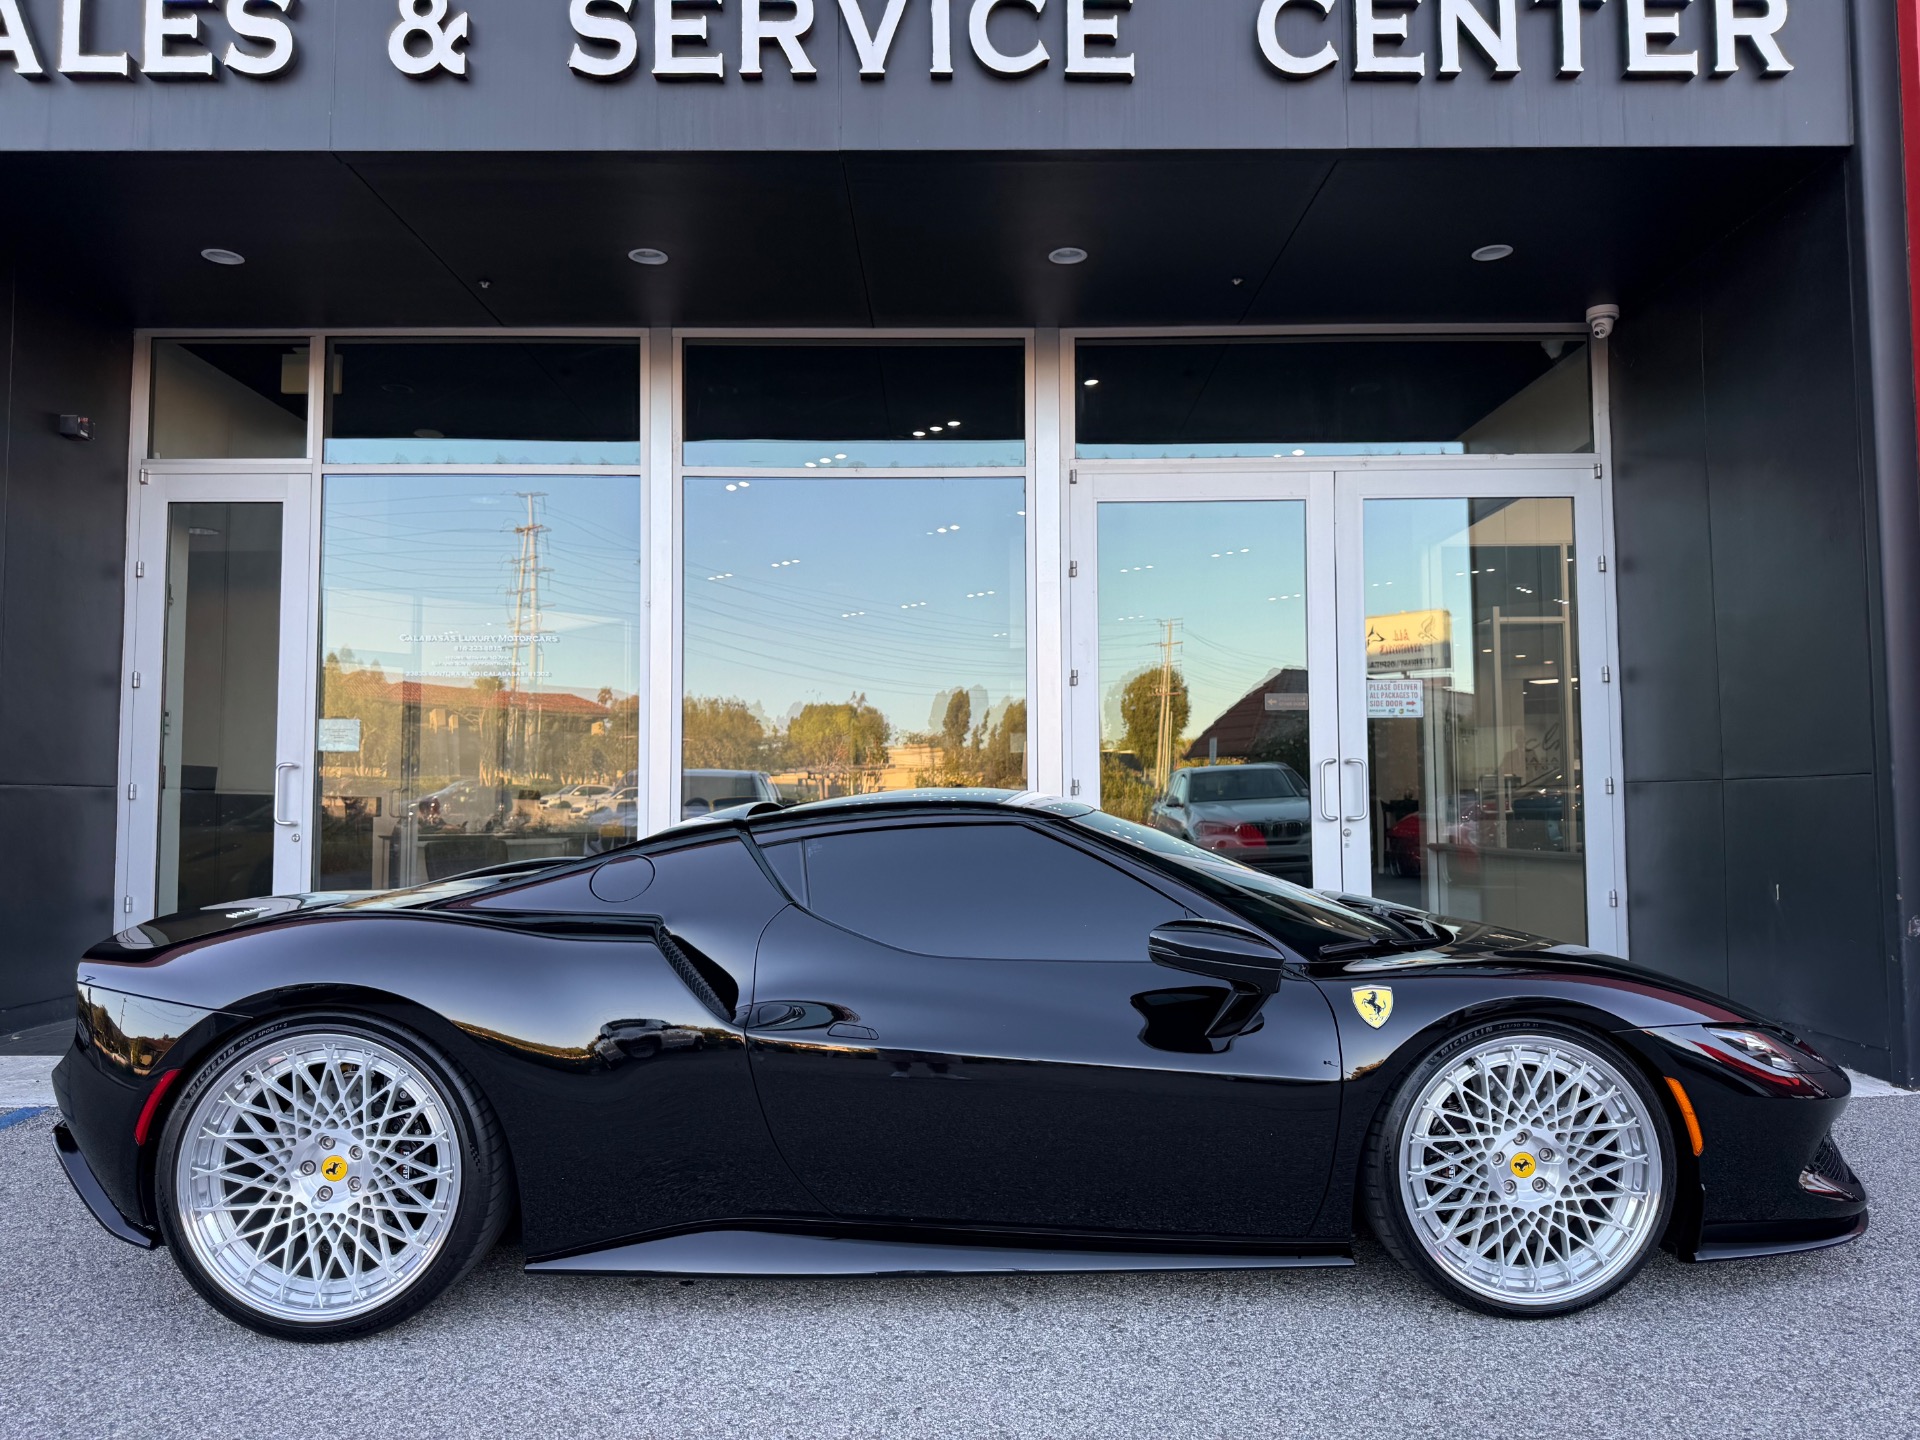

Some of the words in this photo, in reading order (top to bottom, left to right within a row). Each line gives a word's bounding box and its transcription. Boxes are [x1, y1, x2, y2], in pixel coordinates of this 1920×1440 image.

[388, 0, 468, 75] &
[567, 0, 1136, 78] SERVICE
[1257, 0, 1795, 77] CENTER
[399, 634, 457, 643] CALABASAS
[459, 634, 495, 643] LUXURY
[498, 634, 559, 643] MOTORCARS
[1369, 683, 1391, 691] PLEASE
[1393, 683, 1418, 691] DELIVER
[1369, 691, 1380, 699] ALL
[1381, 691, 1410, 699] PACKAGES
[1411, 691, 1419, 699] TO
[1440, 1025, 1494, 1057] MICHELIN
[187, 1045, 236, 1097] MICHELIN
[239, 1034, 257, 1047] PILOT
[258, 1025, 280, 1037] SPORT
